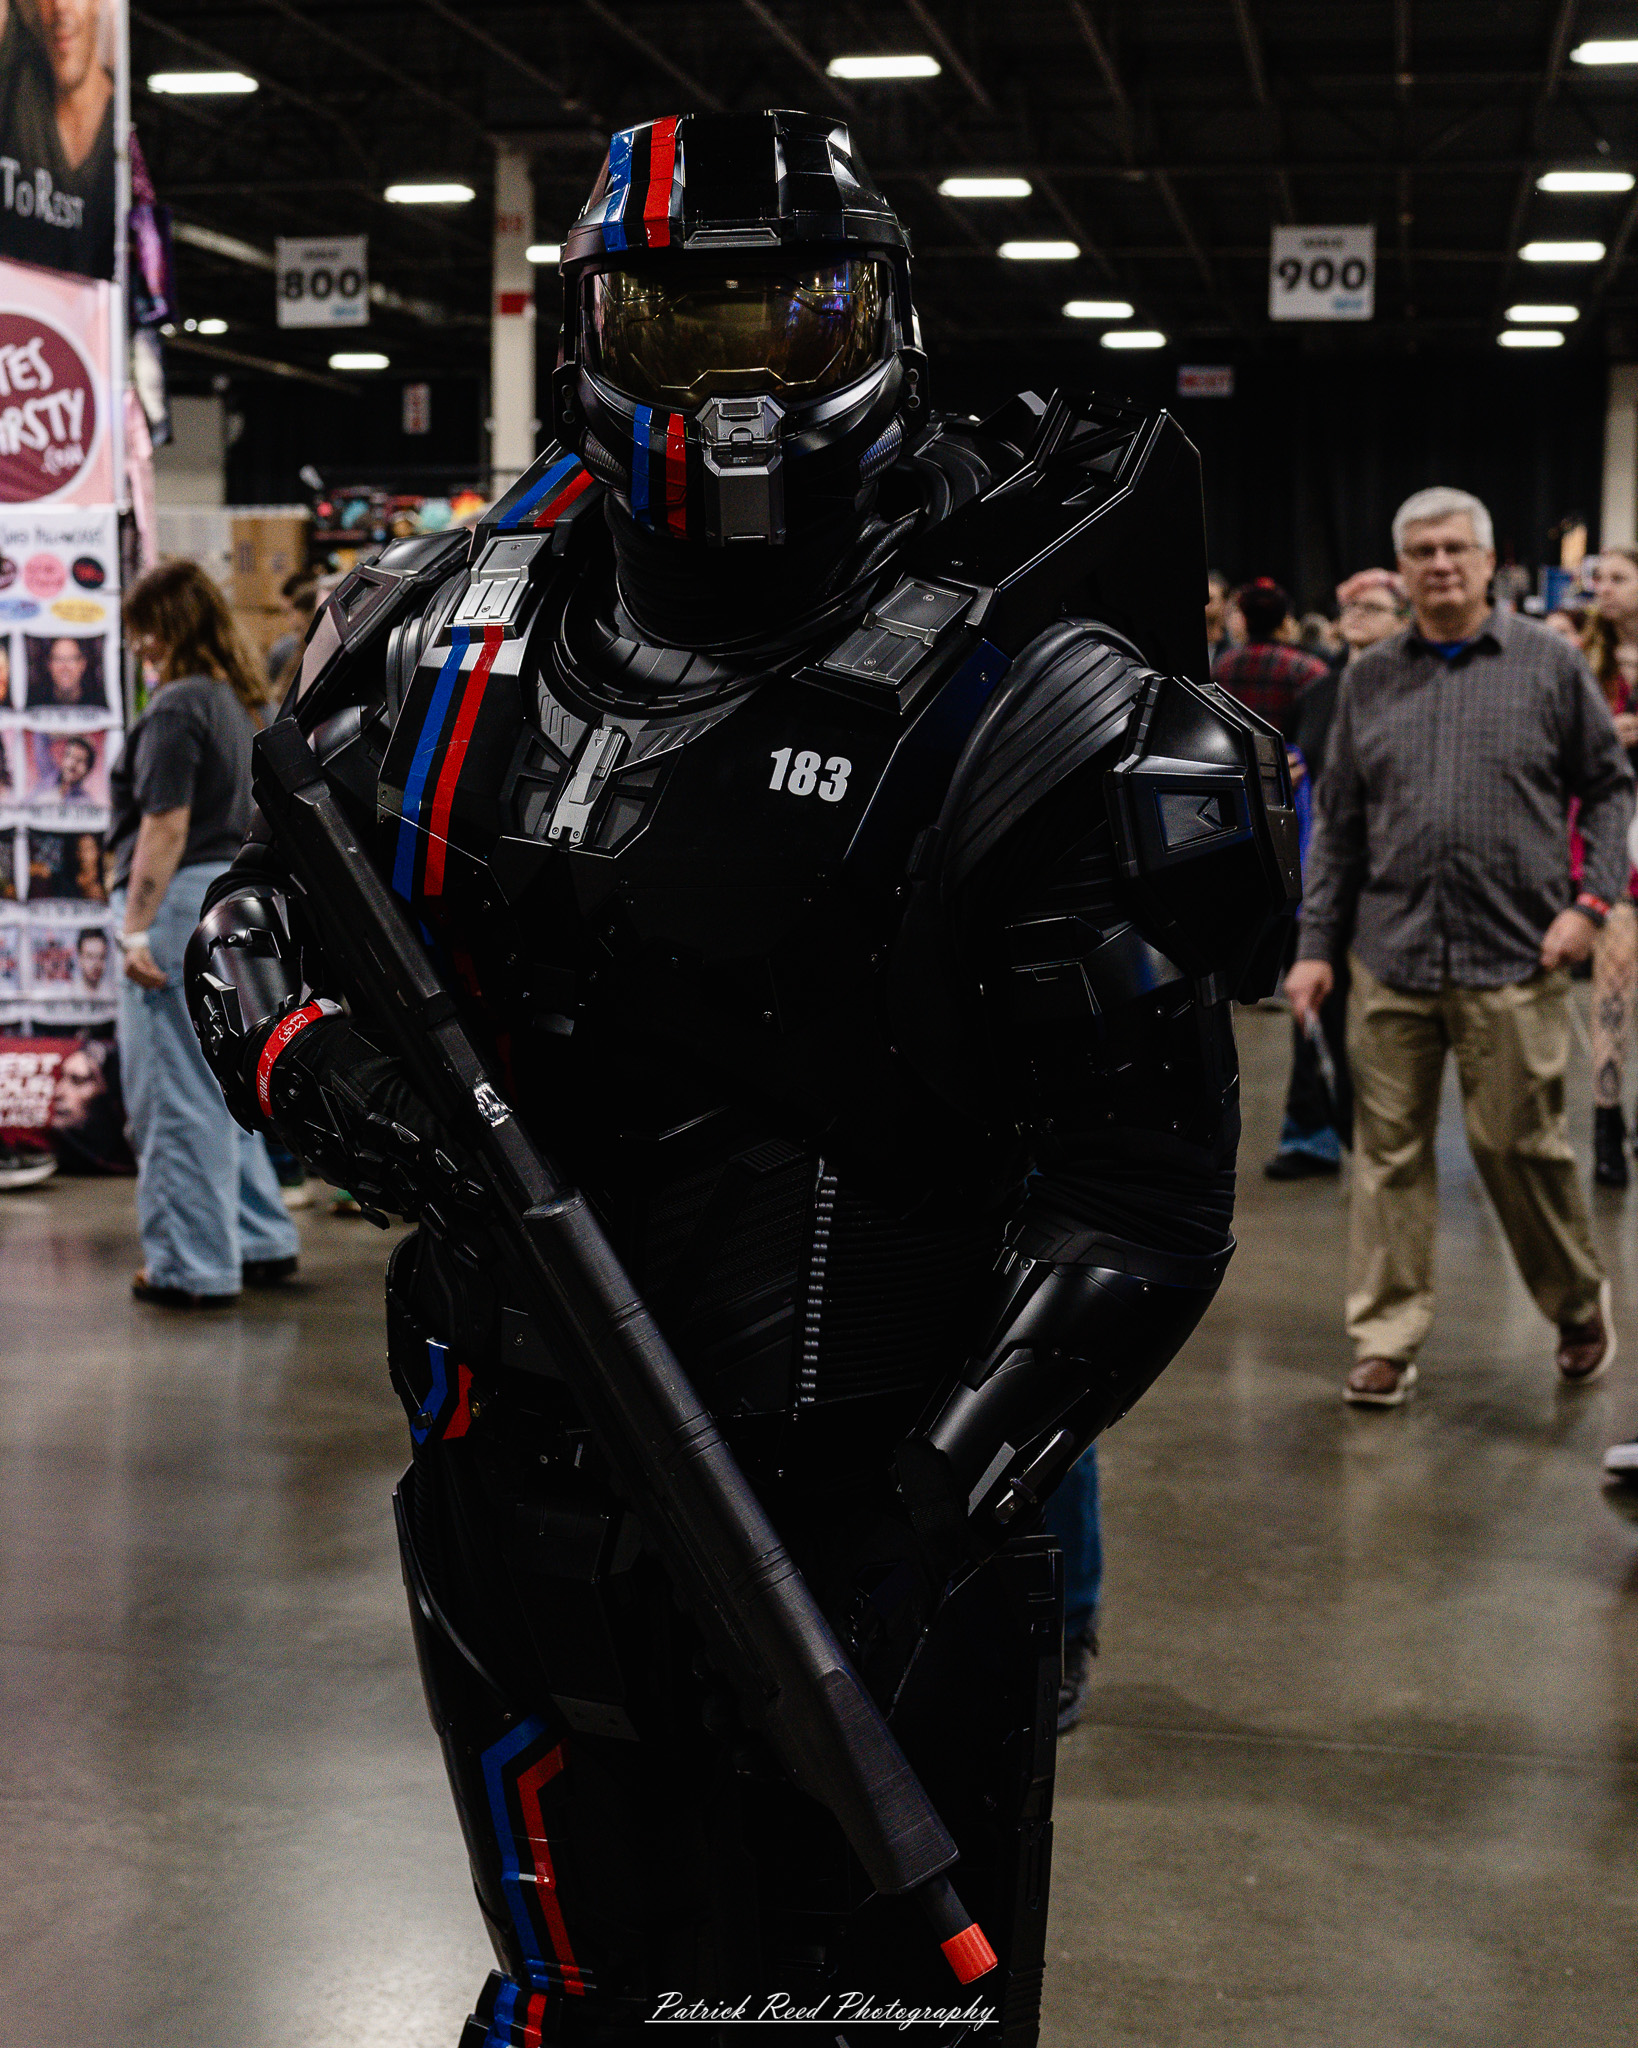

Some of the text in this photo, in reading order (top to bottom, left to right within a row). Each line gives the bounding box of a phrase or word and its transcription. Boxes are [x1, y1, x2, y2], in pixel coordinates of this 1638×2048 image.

[285, 268, 361, 301] 800
[1279, 258, 1366, 292] 900
[769, 747, 852, 802] 183
